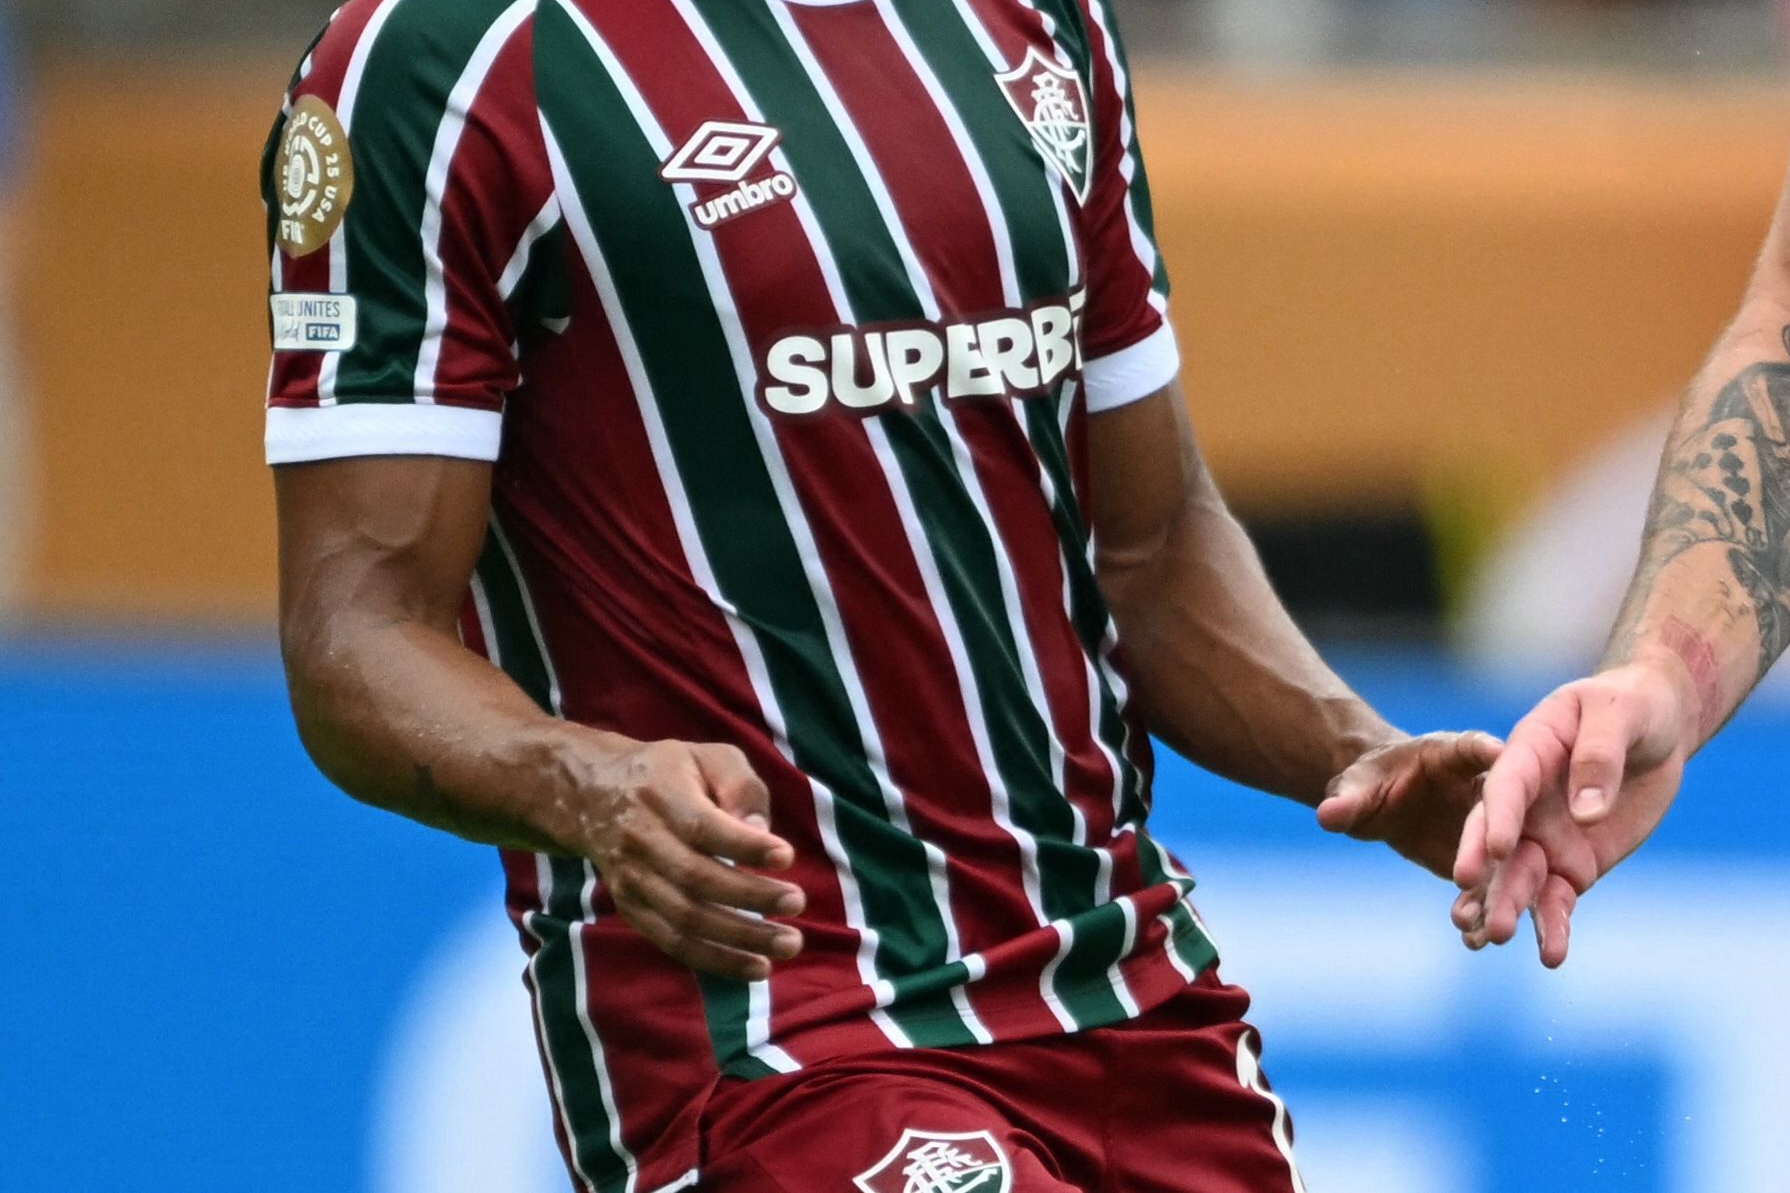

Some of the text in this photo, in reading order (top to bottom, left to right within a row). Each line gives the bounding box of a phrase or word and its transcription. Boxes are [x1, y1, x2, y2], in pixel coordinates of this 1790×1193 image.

[308, 115, 333, 147] CUP
[325, 152, 340, 178] 25
[311, 185, 337, 224] USA
[694, 171, 794, 226] umbro
[297, 300, 341, 318] UNITES
[308, 325, 339, 340] FIFA
